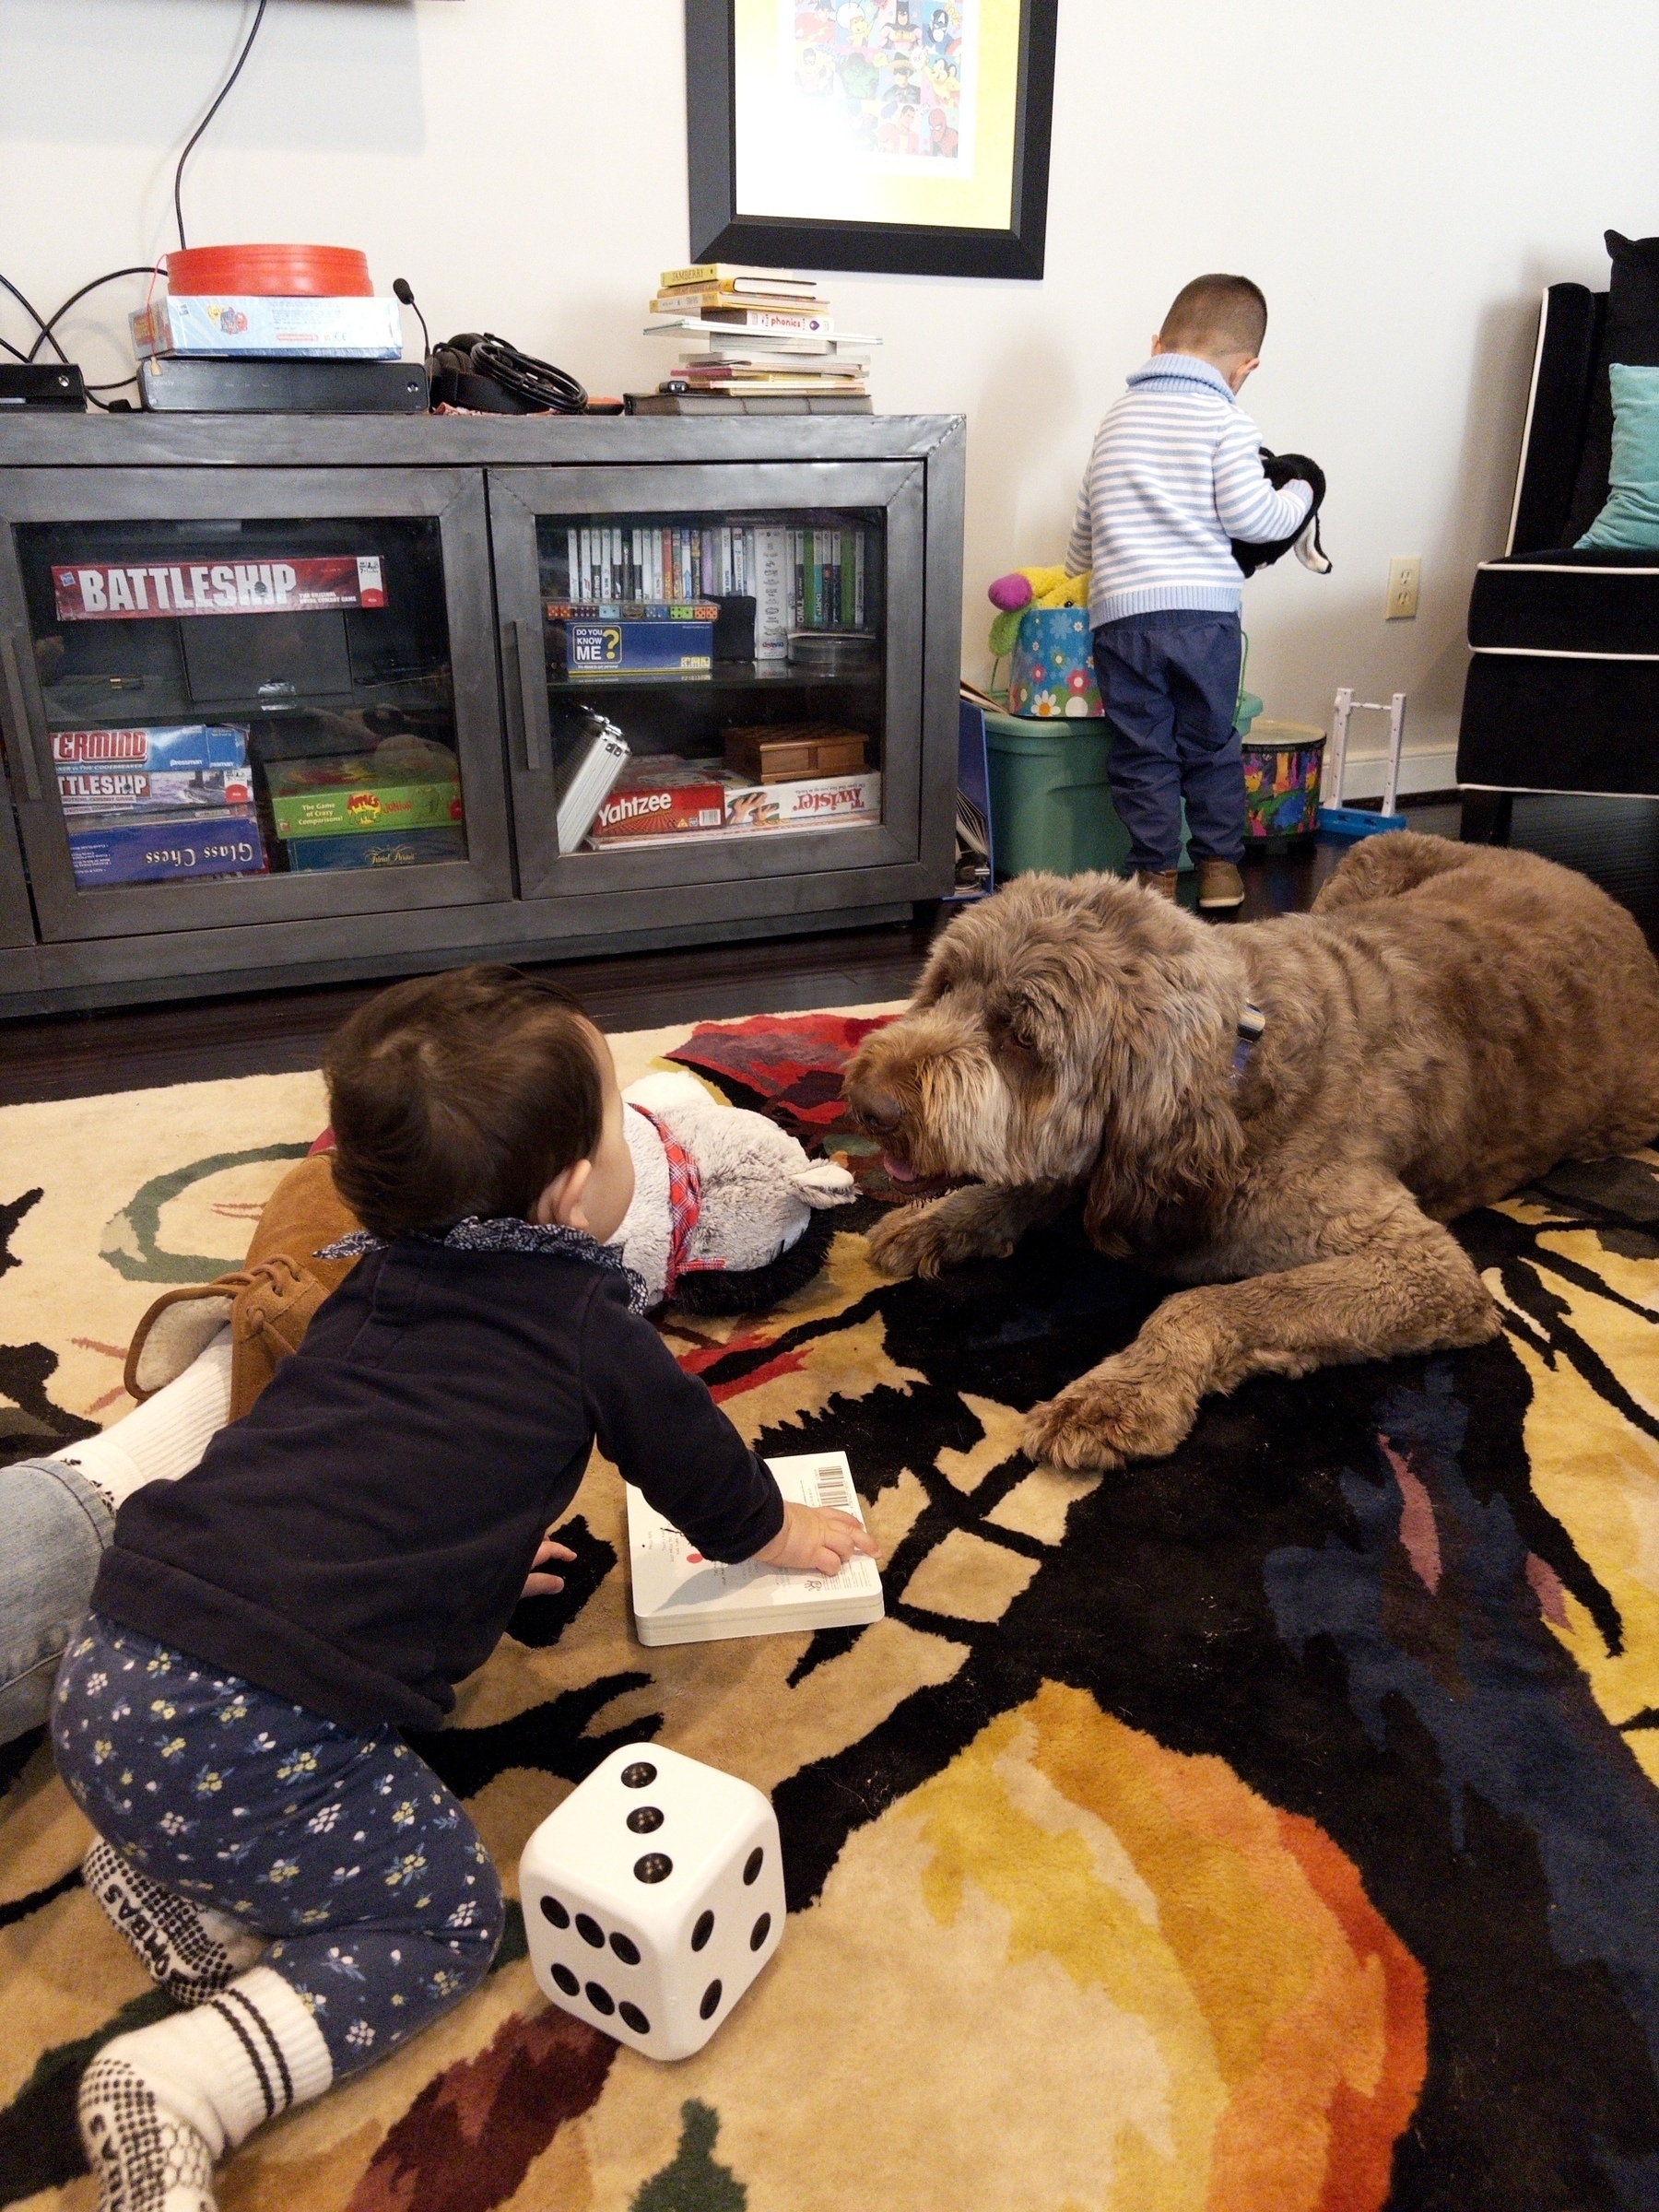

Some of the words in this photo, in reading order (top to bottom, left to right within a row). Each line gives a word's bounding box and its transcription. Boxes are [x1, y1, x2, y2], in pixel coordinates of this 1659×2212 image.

[672, 269, 703, 281] JAMBERRY
[771, 316, 801, 327] phonics
[77, 563, 297, 613] BATTLESHIP
[576, 637, 603, 645] KNOW
[576, 646, 602, 660] ME
[170, 759, 203, 767] pressman
[793, 788, 865, 812] Twister
[314, 809, 334, 818] Crazy
[598, 793, 672, 827] Yahtzee
[298, 817, 344, 826] Comparisons!
[144, 847, 196, 868] Chess
[203, 841, 253, 863] Glass
